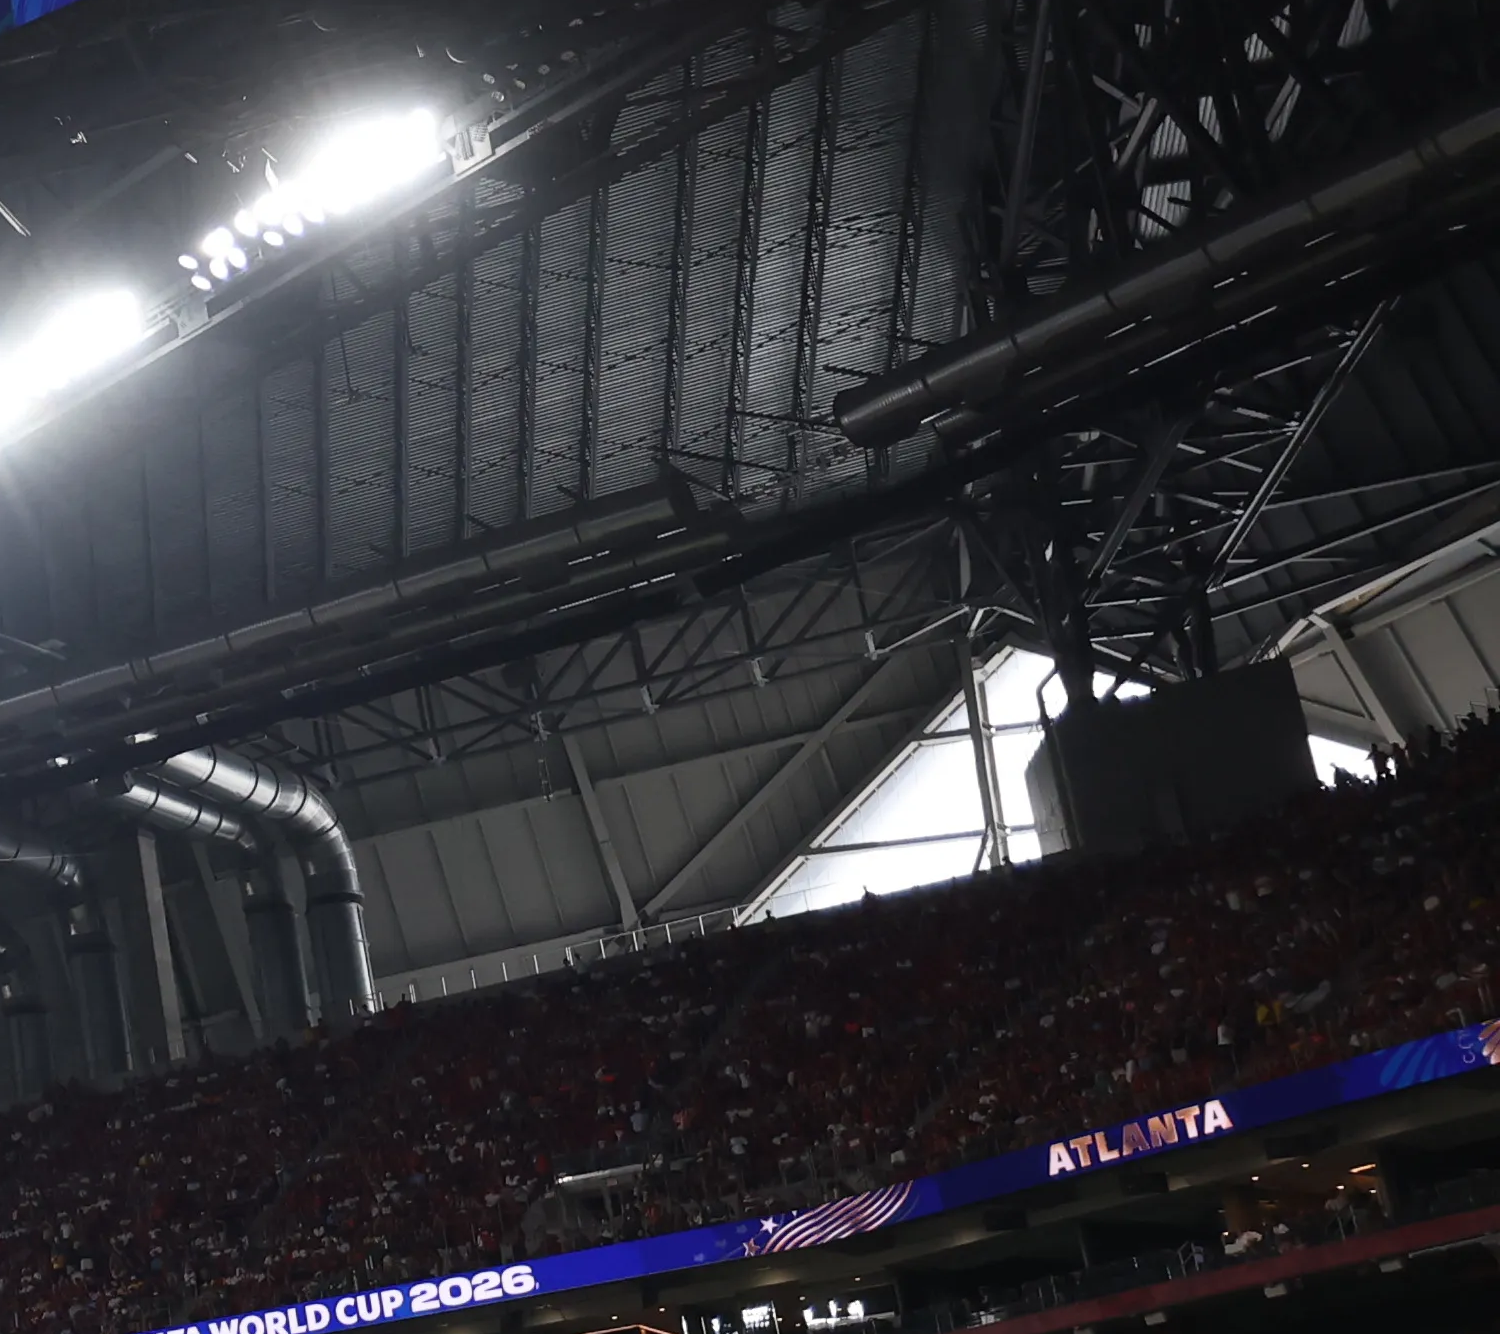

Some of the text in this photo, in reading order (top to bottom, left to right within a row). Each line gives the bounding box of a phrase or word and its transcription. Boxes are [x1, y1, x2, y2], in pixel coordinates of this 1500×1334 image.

[1047, 1098, 1233, 1176] ATLANTA
[336, 1288, 402, 1324] CUP
[408, 1265, 534, 1313] 2026
